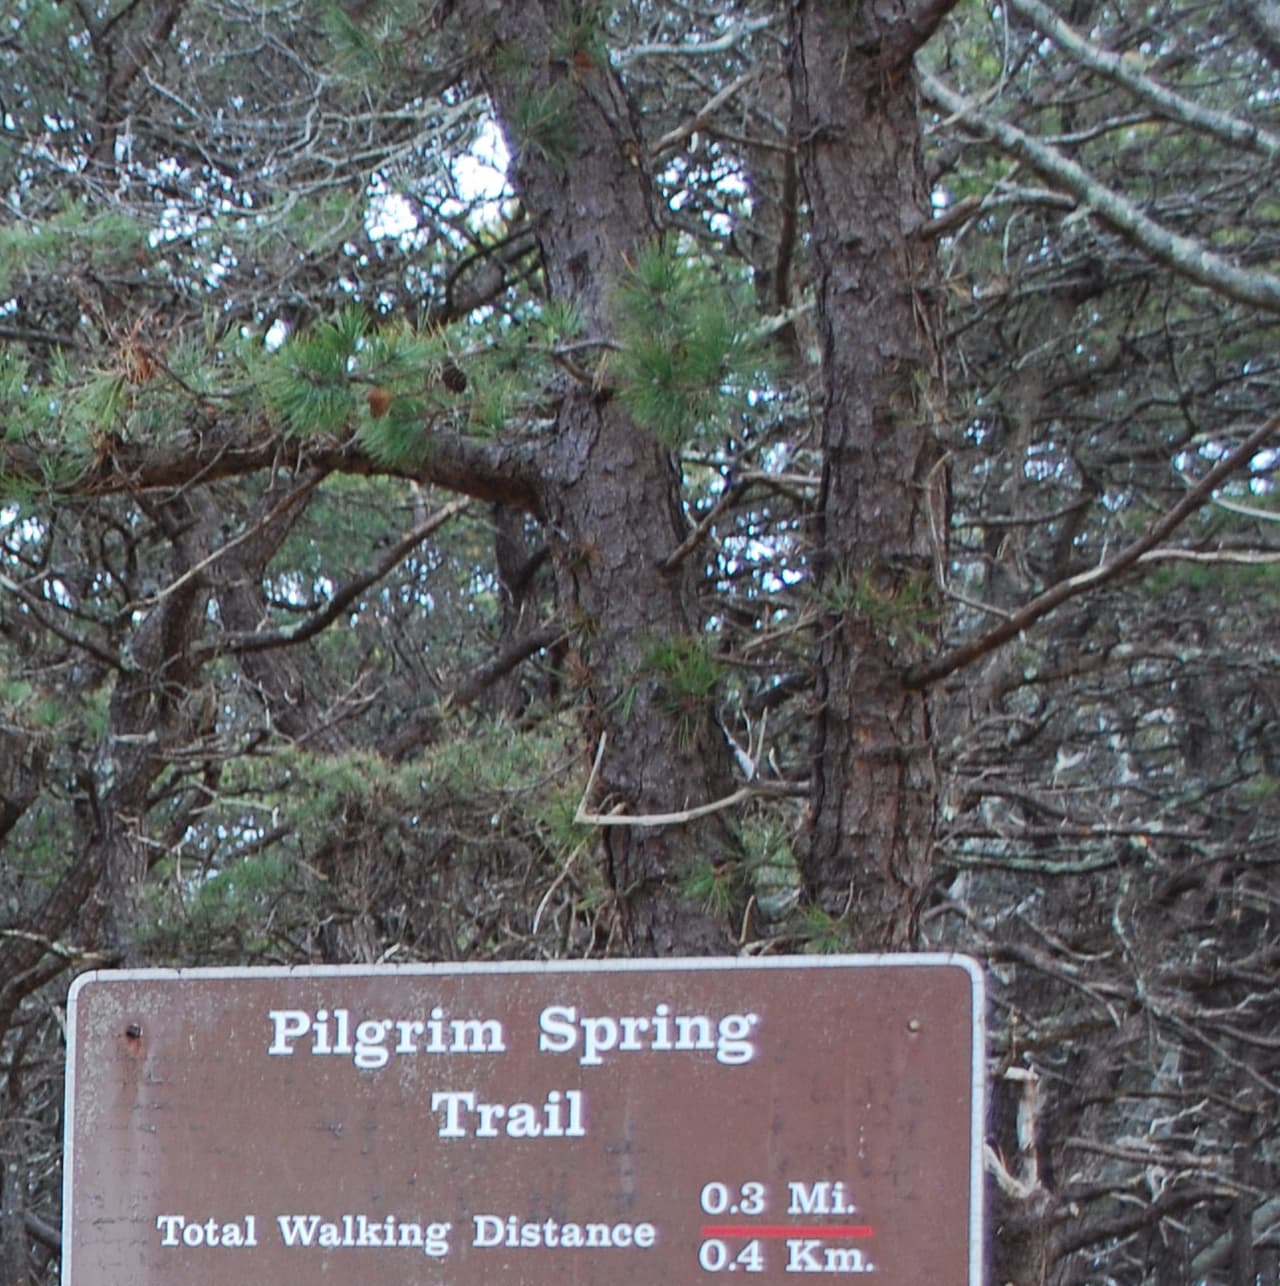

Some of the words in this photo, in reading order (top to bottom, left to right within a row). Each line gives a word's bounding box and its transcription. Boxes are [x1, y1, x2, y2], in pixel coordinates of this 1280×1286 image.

[268, 1008, 506, 1069] Pilgrim
[539, 1004, 758, 1065] Spring
[431, 1090, 586, 1137] Trail
[700, 1181, 765, 1214] 0.3
[787, 1181, 857, 1214] Mi.
[156, 1215, 257, 1247] Total
[278, 1215, 451, 1256] Walking
[472, 1214, 657, 1247] Distance
[698, 1239, 764, 1272] 0.4
[785, 1239, 875, 1272] Km.
